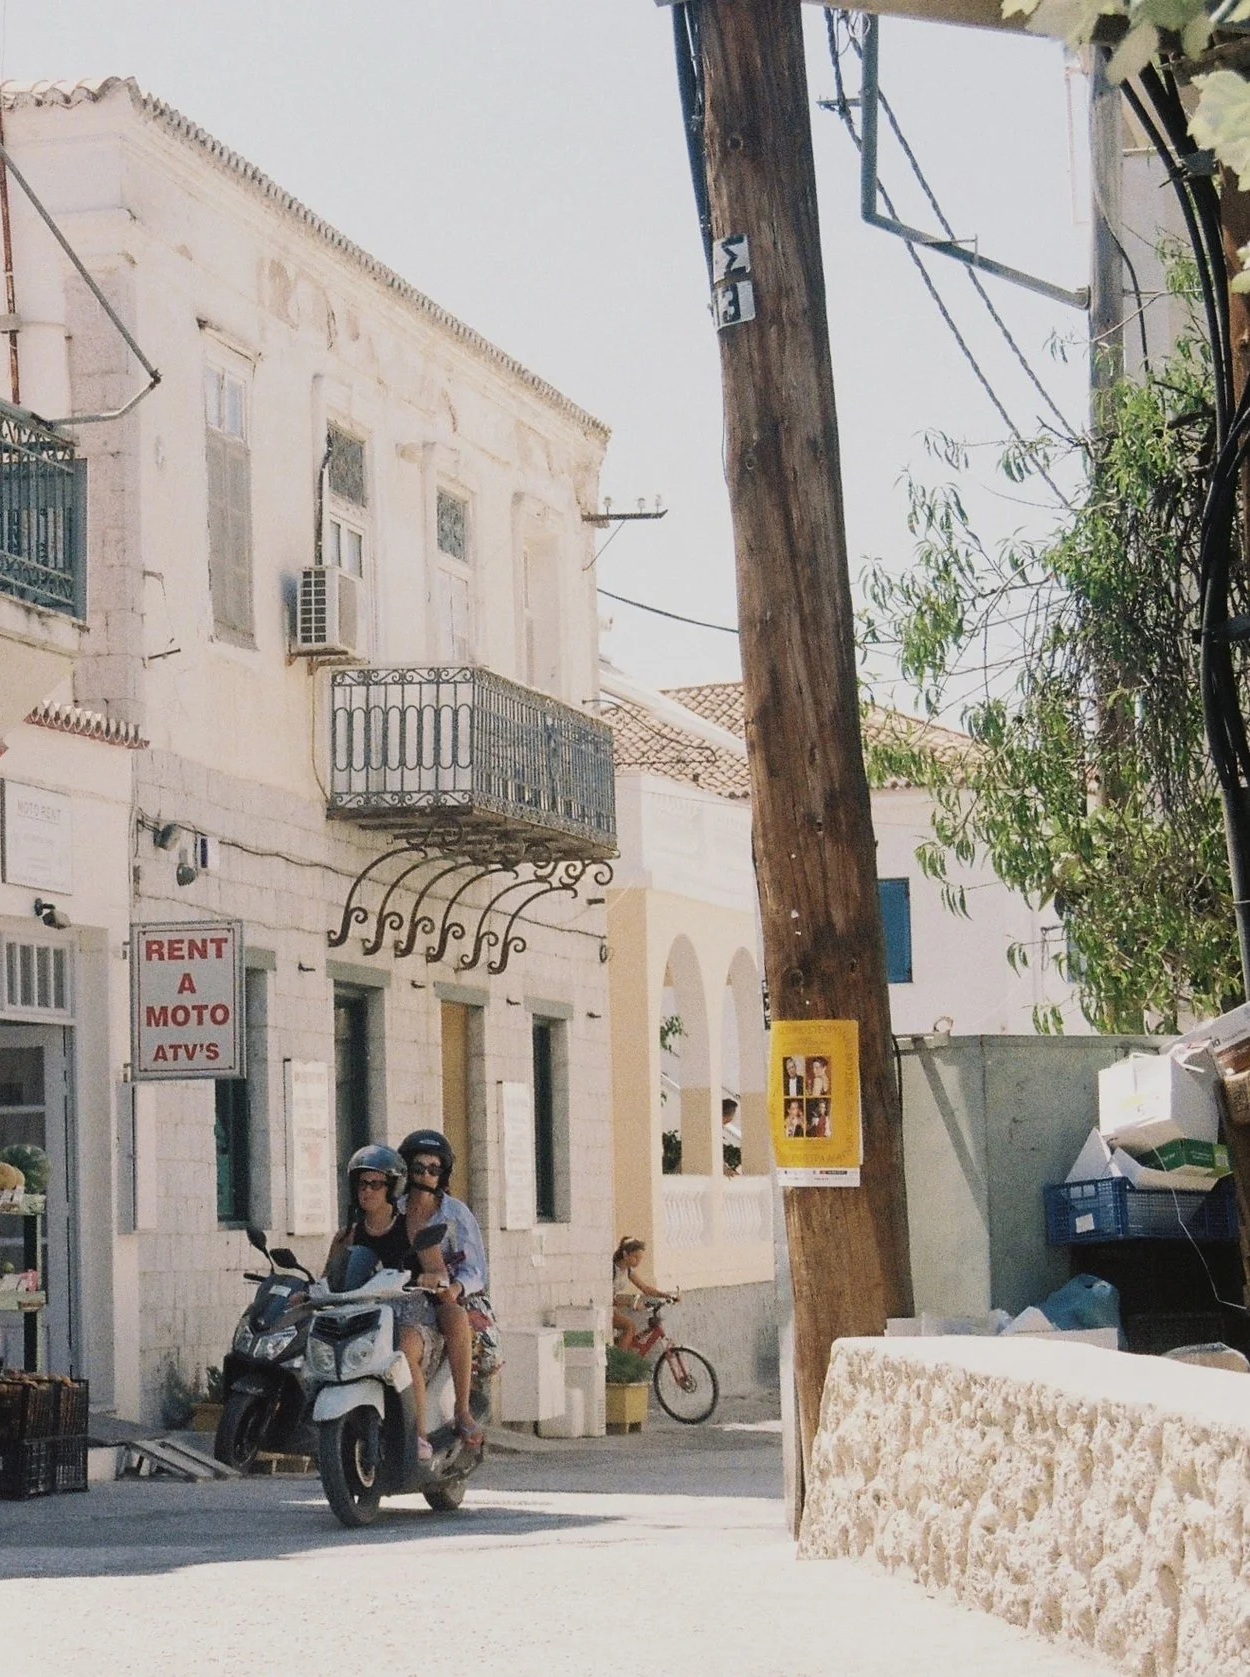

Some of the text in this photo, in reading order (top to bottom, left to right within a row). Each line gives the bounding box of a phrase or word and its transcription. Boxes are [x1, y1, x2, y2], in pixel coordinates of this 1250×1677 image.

[145, 937, 228, 961] RENT
[177, 973, 197, 994] A
[146, 1003, 230, 1027] MOTO
[153, 1042, 220, 1062] ATV'S
